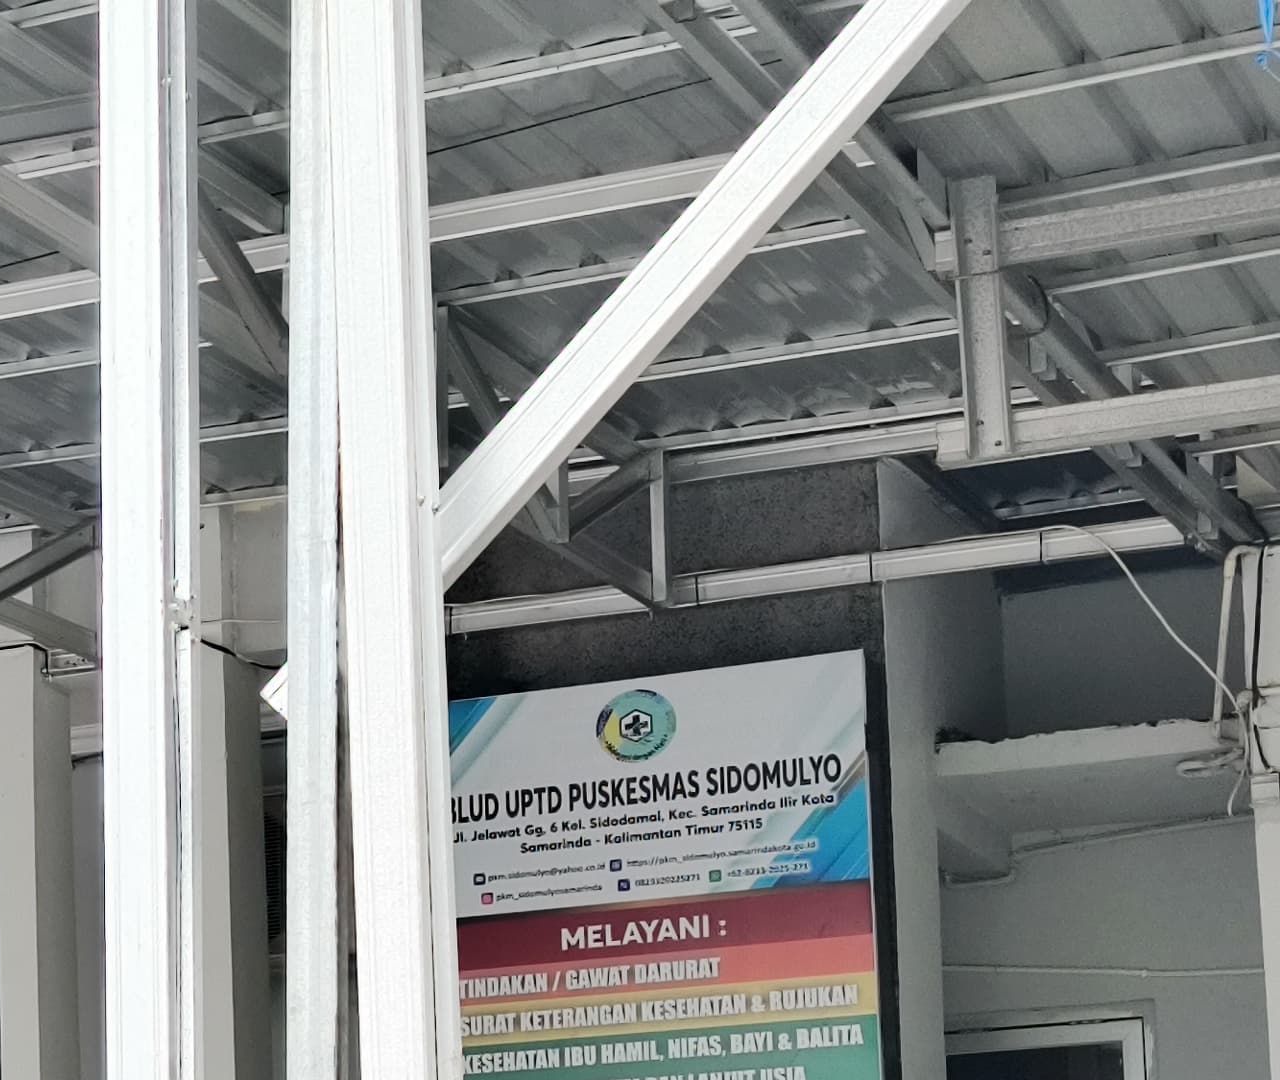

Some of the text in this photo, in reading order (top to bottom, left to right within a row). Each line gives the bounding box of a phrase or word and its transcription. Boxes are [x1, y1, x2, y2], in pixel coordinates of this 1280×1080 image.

[506, 787, 562, 818] UPTD
[569, 770, 700, 812] PUSKESMAS
[705, 754, 842, 796] SIDOMULYO
[453, 831, 467, 844] Jl.
[471, 827, 521, 842] Jelawat
[550, 822, 558, 833] 6
[701, 802, 776, 817] Samarinda
[780, 796, 797, 809] Ilir
[802, 794, 835, 805] Kota
[520, 837, 591, 854] Samarinda
[604, 828, 682, 845] Kalimantan
[685, 823, 724, 837] Timur
[728, 818, 763, 832] 75115
[560, 914, 710, 951] MELAYANI
[460, 956, 721, 1000] TINDAKAN / GAWAT DARURAT
[460, 984, 858, 1038] SURAT KETERANGAN KESEHATAN & RUJUKAN
[463, 1022, 864, 1074] KESEHATAN IBU HAMIL, NIFAS, BAYI & BALITA
